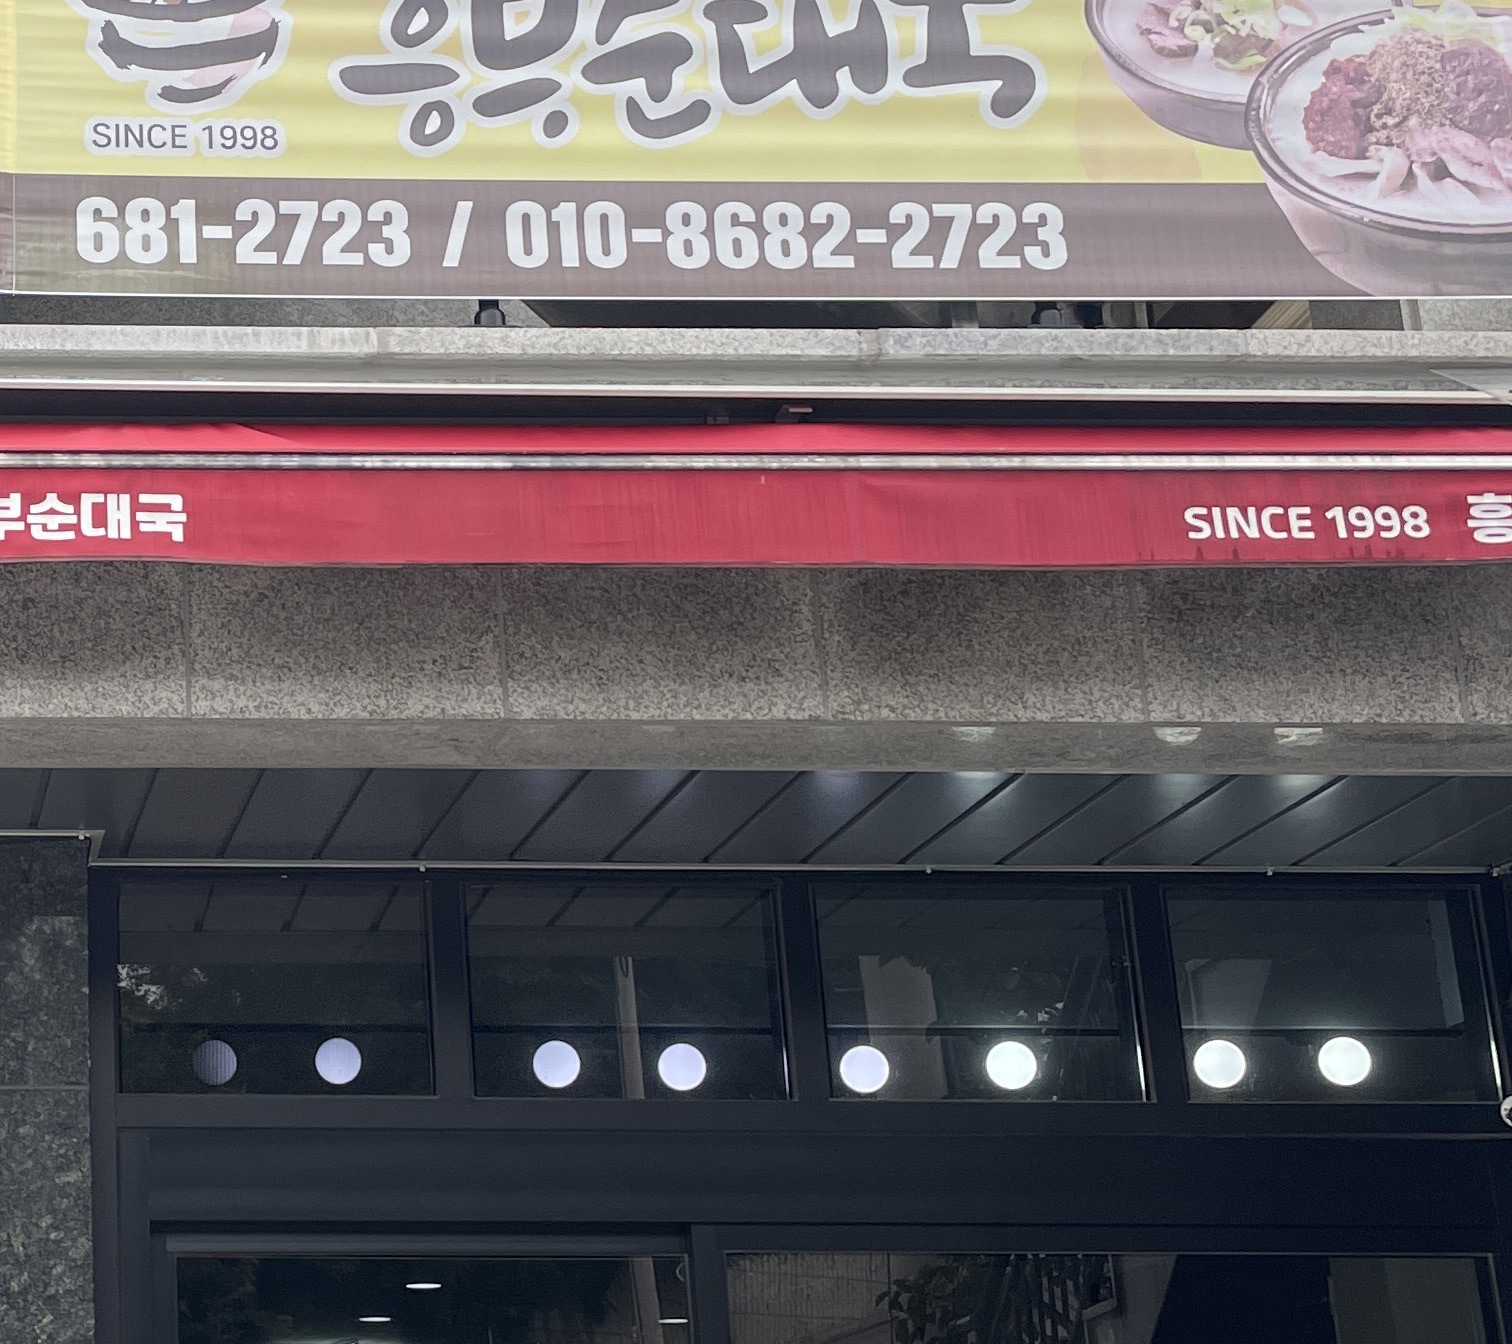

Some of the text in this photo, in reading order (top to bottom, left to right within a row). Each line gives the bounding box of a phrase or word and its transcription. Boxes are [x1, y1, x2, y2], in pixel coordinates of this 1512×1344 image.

[91, 122, 279, 152] SINCE 1998
[75, 195, 411, 267] 681-2723
[505, 200, 1068, 270] 010-8682-2723
[1183, 505, 1316, 540] SINCE
[1324, 505, 1431, 539] 1998
